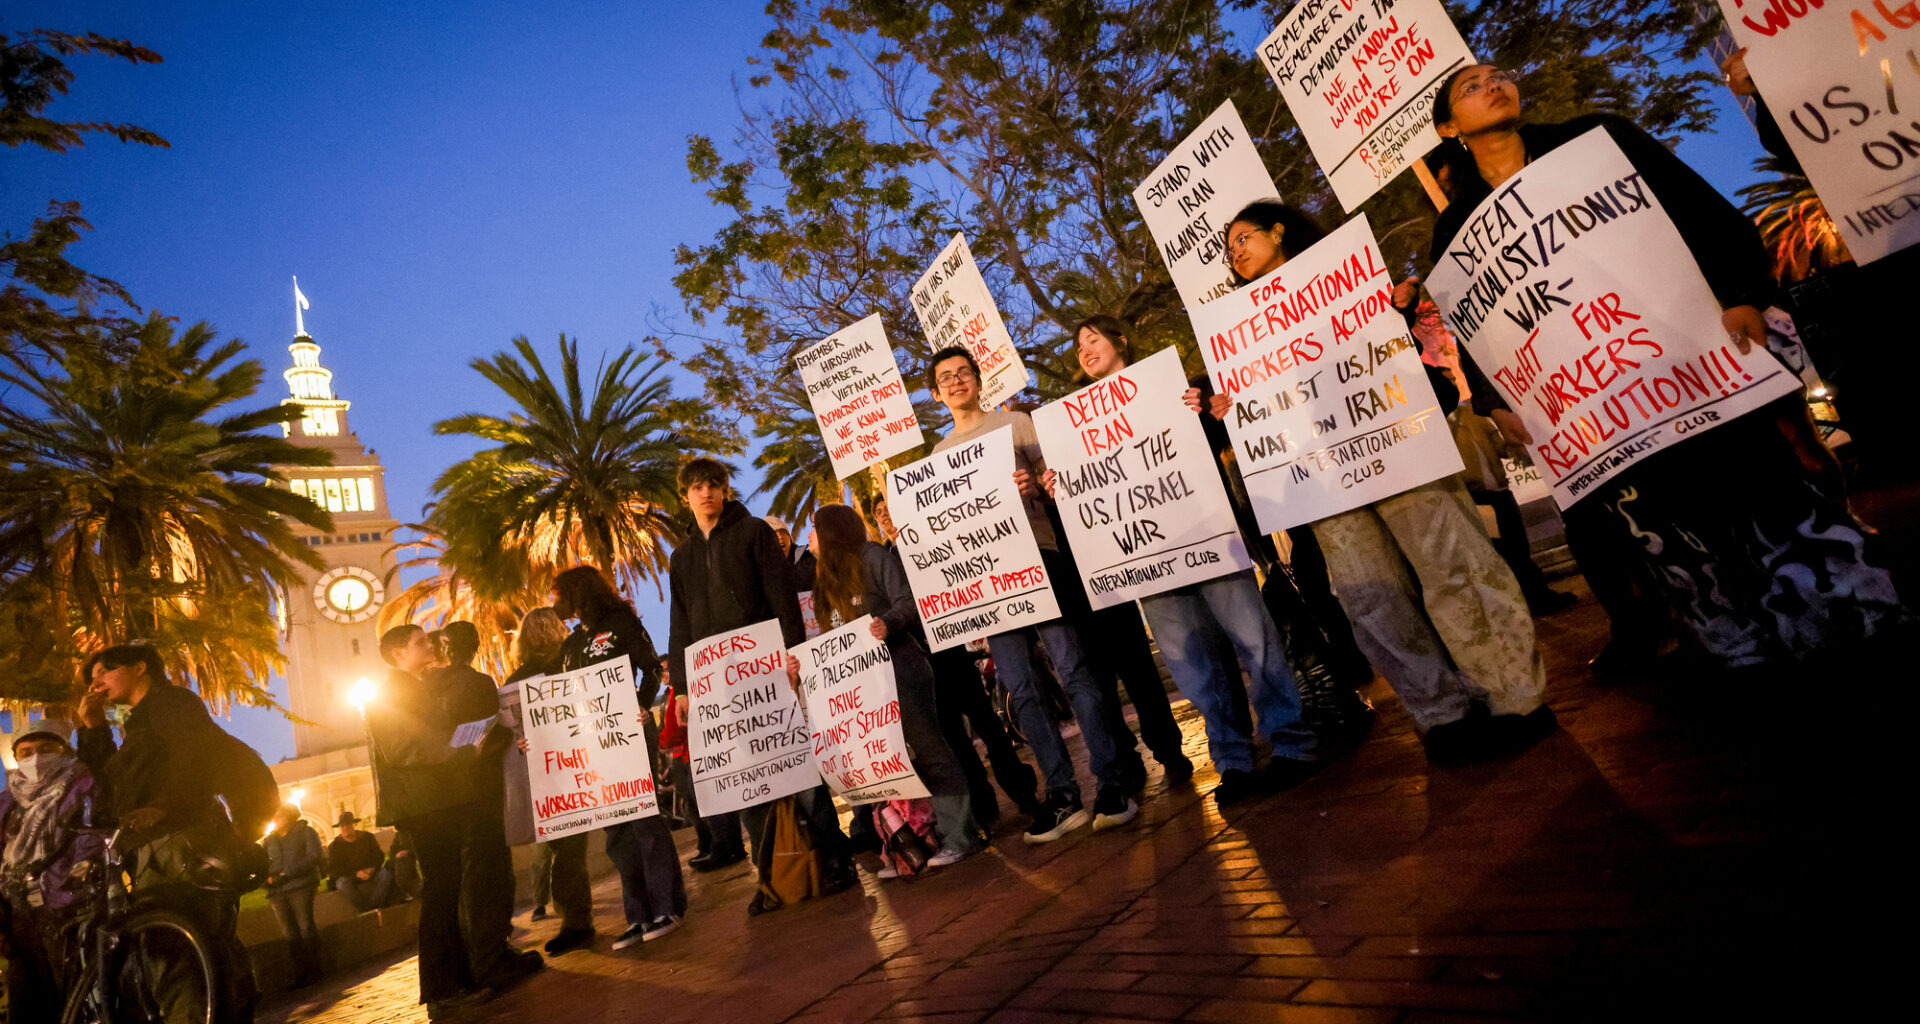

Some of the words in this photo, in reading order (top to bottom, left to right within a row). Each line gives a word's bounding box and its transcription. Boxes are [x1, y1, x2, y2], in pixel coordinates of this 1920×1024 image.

[1277, 4, 1343, 86] REMEMBER
[1850, 0, 1920, 57] AG
[1299, 14, 1368, 96] DEMOCRATIC
[1322, 72, 1347, 107] WE
[1351, 14, 1399, 72] KNOW
[1330, 72, 1373, 130] WHICH
[1378, 21, 1421, 74] SIDE
[1354, 74, 1402, 135] YOU'RE
[1406, 37, 1435, 77] ON
[1368, 107, 1433, 173] INTERNATIONAL
[1146, 164, 1190, 208] STAND
[1192, 125, 1235, 168] WITH
[1374, 152, 1405, 187] YOUTH
[1178, 177, 1215, 218] IRAN
[1164, 211, 1213, 269] AGAINST
[1449, 177, 1536, 278] DEFEAT
[914, 285, 931, 316] IRAN
[928, 270, 944, 294] HAS
[927, 290, 955, 332] NUCLEAR
[1209, 244, 1387, 363] INTERNATIONAL
[1249, 275, 1287, 307] FOR
[932, 313, 960, 352] WEAPONS
[960, 304, 971, 319] to
[962, 312, 990, 345] ISRAEL
[1217, 331, 1324, 396] WORKERS
[1330, 281, 1395, 346] ACTION
[1493, 327, 1544, 407] FIGHT
[1571, 292, 1641, 341] FOR
[797, 338, 845, 370] REMEMBER
[820, 340, 874, 374] HIROSHIMA
[1534, 327, 1664, 427] WORKERS
[807, 365, 863, 397] REMEMBER
[819, 394, 871, 428] DEMOCRATIC
[871, 379, 904, 405] PARTY
[1062, 374, 1139, 429] DEFEND
[1235, 369, 1323, 429] AGAINST
[835, 422, 854, 441] WE
[857, 407, 887, 430] KNOW
[1081, 412, 1134, 457] IRAN
[1243, 427, 1297, 463] WAR
[1312, 414, 1338, 440] ON
[1344, 373, 1409, 428] IRAN
[1538, 346, 1754, 479] REVOLUTION!!!
[830, 440, 855, 461] WHAT
[856, 429, 881, 450] SIDE
[881, 413, 918, 437] YOU'RE
[862, 447, 880, 462] ON
[1290, 413, 1431, 485] INTERNATIONALIST
[1567, 430, 1662, 497] INTERNATIONALIST
[1674, 410, 1722, 435] CLUB
[894, 461, 936, 495] DOWN
[947, 443, 985, 470] WITH
[1058, 446, 1129, 501] AGAINST
[1133, 428, 1177, 472] THE
[1340, 458, 1386, 490] CLUB
[1514, 469, 1543, 486] PAL
[915, 469, 979, 512] ATTEMPT
[898, 522, 920, 547] TO
[926, 488, 1001, 535] RESTORE
[1113, 519, 1166, 556] WAR
[909, 539, 956, 571] BLOODY
[956, 516, 1020, 553] PAHLAVI
[918, 579, 985, 620] IMPERIALIST
[990, 565, 1045, 595] PUPPETS
[1088, 557, 1177, 596] INTERNATIONALIST
[1184, 550, 1221, 568] CLUB
[931, 605, 1001, 645] INTERNATIONALIST
[1006, 599, 1036, 617] CLUB
[692, 633, 757, 671] WORKERS
[803, 674, 818, 698] THE
[822, 643, 891, 689] PALESTINIANS
[811, 632, 857, 668] DEFEND
[525, 672, 591, 705] DEFEAT
[595, 665, 625, 688] THE
[690, 672, 716, 702] MUST
[724, 650, 783, 686] CRUSH
[529, 692, 610, 728] IMPERIALIST/
[698, 682, 778, 723] PRO-SHAH
[702, 700, 798, 748] IMPERIALIST/
[828, 685, 864, 718] DRIVE
[856, 700, 901, 740] SETTLERS
[568, 712, 624, 738] ZIONIST
[750, 725, 809, 756] PUPPETS
[544, 747, 590, 775] FIGHT
[575, 769, 605, 789] FOR
[714, 752, 811, 794] INTERNATIONALIST
[821, 754, 837, 775] OUT
[842, 751, 855, 768] OF
[864, 738, 888, 759] THE
[837, 766, 866, 789] WEST
[872, 752, 909, 780] BANK
[535, 790, 599, 819] WORKERS
[601, 772, 654, 805] REVOLUTION
[741, 783, 771, 802] CLUB
[538, 817, 593, 836] REVOLUTIONARY
